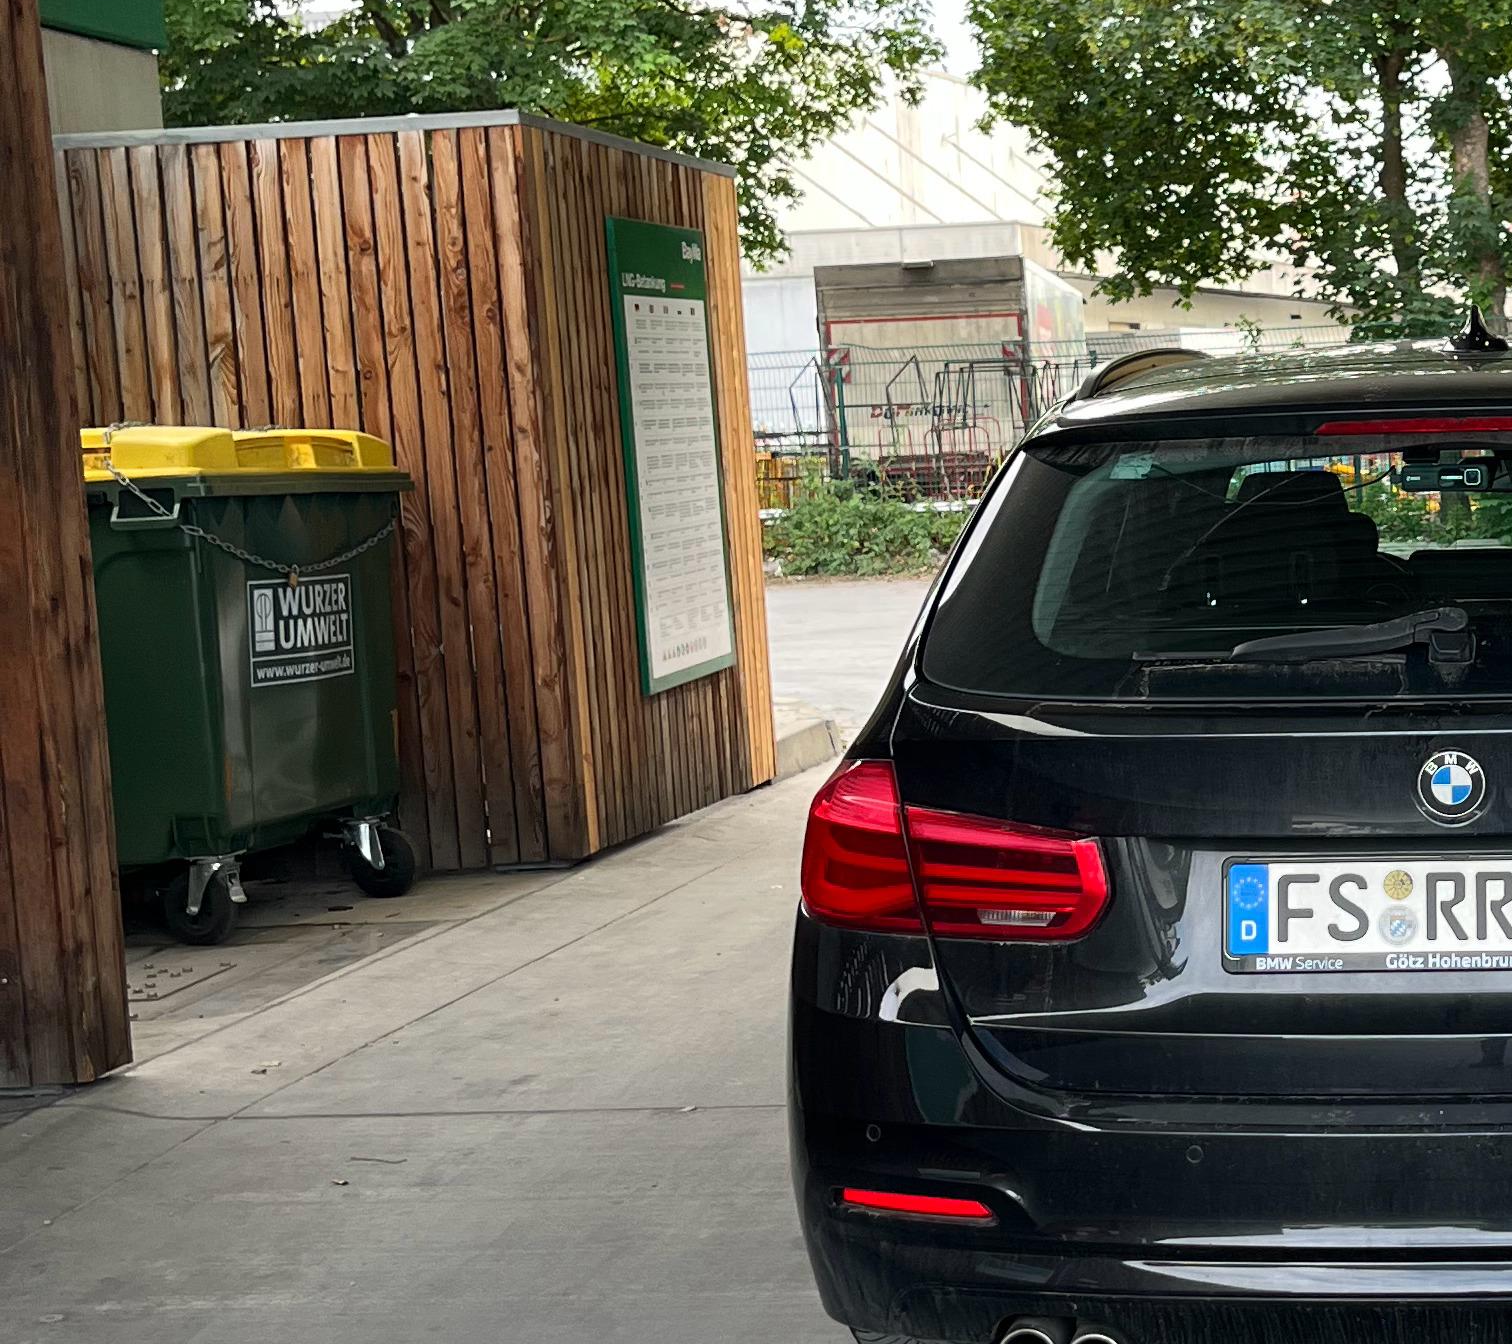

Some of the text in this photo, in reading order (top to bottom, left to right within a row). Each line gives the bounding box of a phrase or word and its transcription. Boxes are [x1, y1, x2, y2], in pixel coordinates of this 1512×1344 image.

[277, 582, 347, 617] WURZER
[279, 613, 349, 650] UMWELT
[256, 653, 351, 680] www.wurzer-umwelt.de
[1425, 754, 1479, 775] BMW
[1277, 873, 1370, 942] FS
[1240, 920, 1257, 941] D
[1255, 956, 1344, 971] BMW Service
[1385, 953, 1425, 969] Götz
